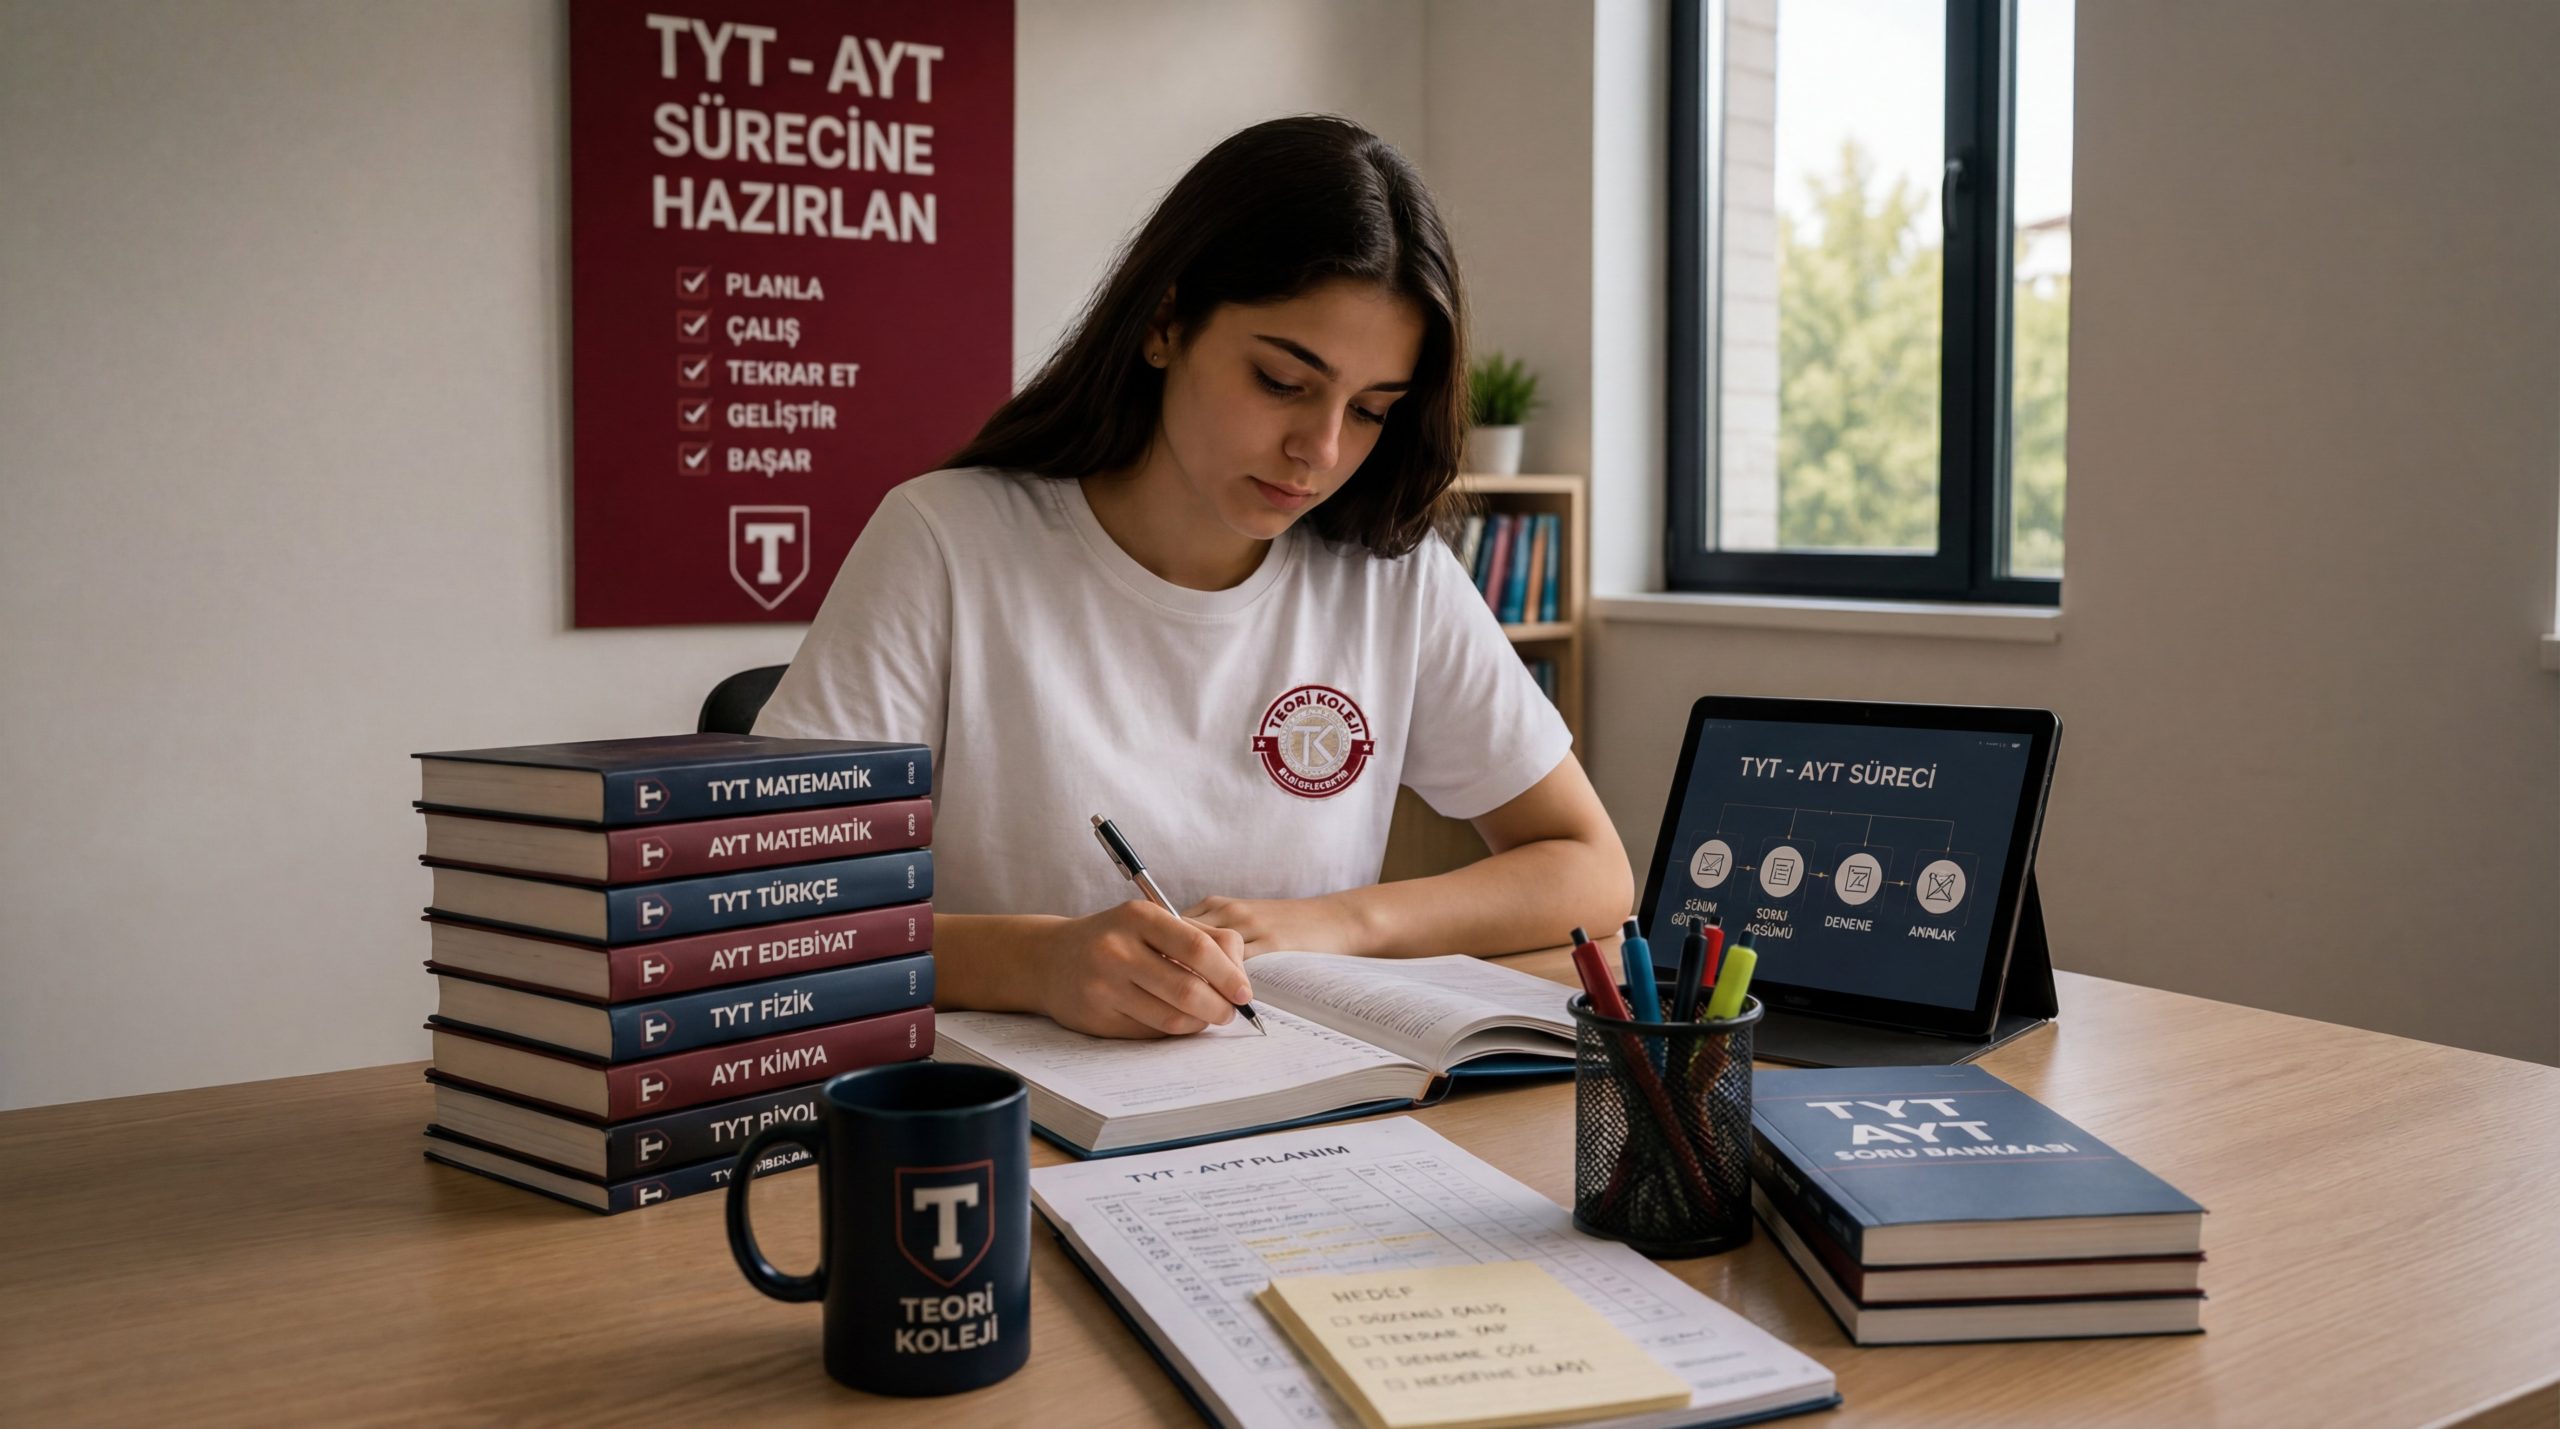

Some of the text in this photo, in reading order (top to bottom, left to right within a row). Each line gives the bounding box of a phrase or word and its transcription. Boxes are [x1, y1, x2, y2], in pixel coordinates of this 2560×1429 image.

[646, 13, 777, 87] TYT
[827, 35, 944, 103] AYT
[653, 92, 935, 176] SÜRECİNE
[653, 175, 937, 244] HAZIRLAN
[726, 272, 824, 301] PLANLA
[727, 316, 801, 348] ÇALIŞ
[726, 360, 859, 388] TEKRAR ET
[727, 400, 837, 434] GELİŞTİR
[727, 448, 812, 477] BAŞAR
[745, 522, 796, 585] T
[1269, 691, 1311, 729] TEORİ
[708, 765, 872, 802] TYT MATEMATİK
[1740, 756, 1782, 779] TYT
[1798, 761, 1844, 783] AYT
[1849, 760, 1937, 789] SÜRECİ
[708, 833, 751, 858] AYT
[756, 817, 872, 852] MATEMATİK
[708, 878, 839, 914] TYT TÜRKÇE
[1824, 915, 1873, 932] DENENE
[710, 930, 858, 972] AYT EDEBİYAT
[710, 989, 814, 1028] TYT FİZİK
[711, 1045, 828, 1087] AYT KİMYA
[1805, 1098, 1961, 1120] TYT
[710, 1115, 754, 1142] TYT
[1851, 1120, 1995, 1145] AYT
[1124, 1168, 1175, 1184] TYT
[1199, 1158, 1246, 1175] AYT
[1250, 1144, 1351, 1166] PLANIM
[1835, 1147, 1918, 1161] SORU
[711, 1168, 733, 1183] TY
[900, 1282, 994, 1324] TEORİ
[1331, 1285, 1414, 1304] HEDEF
[895, 1313, 999, 1354] KOLEJİ
